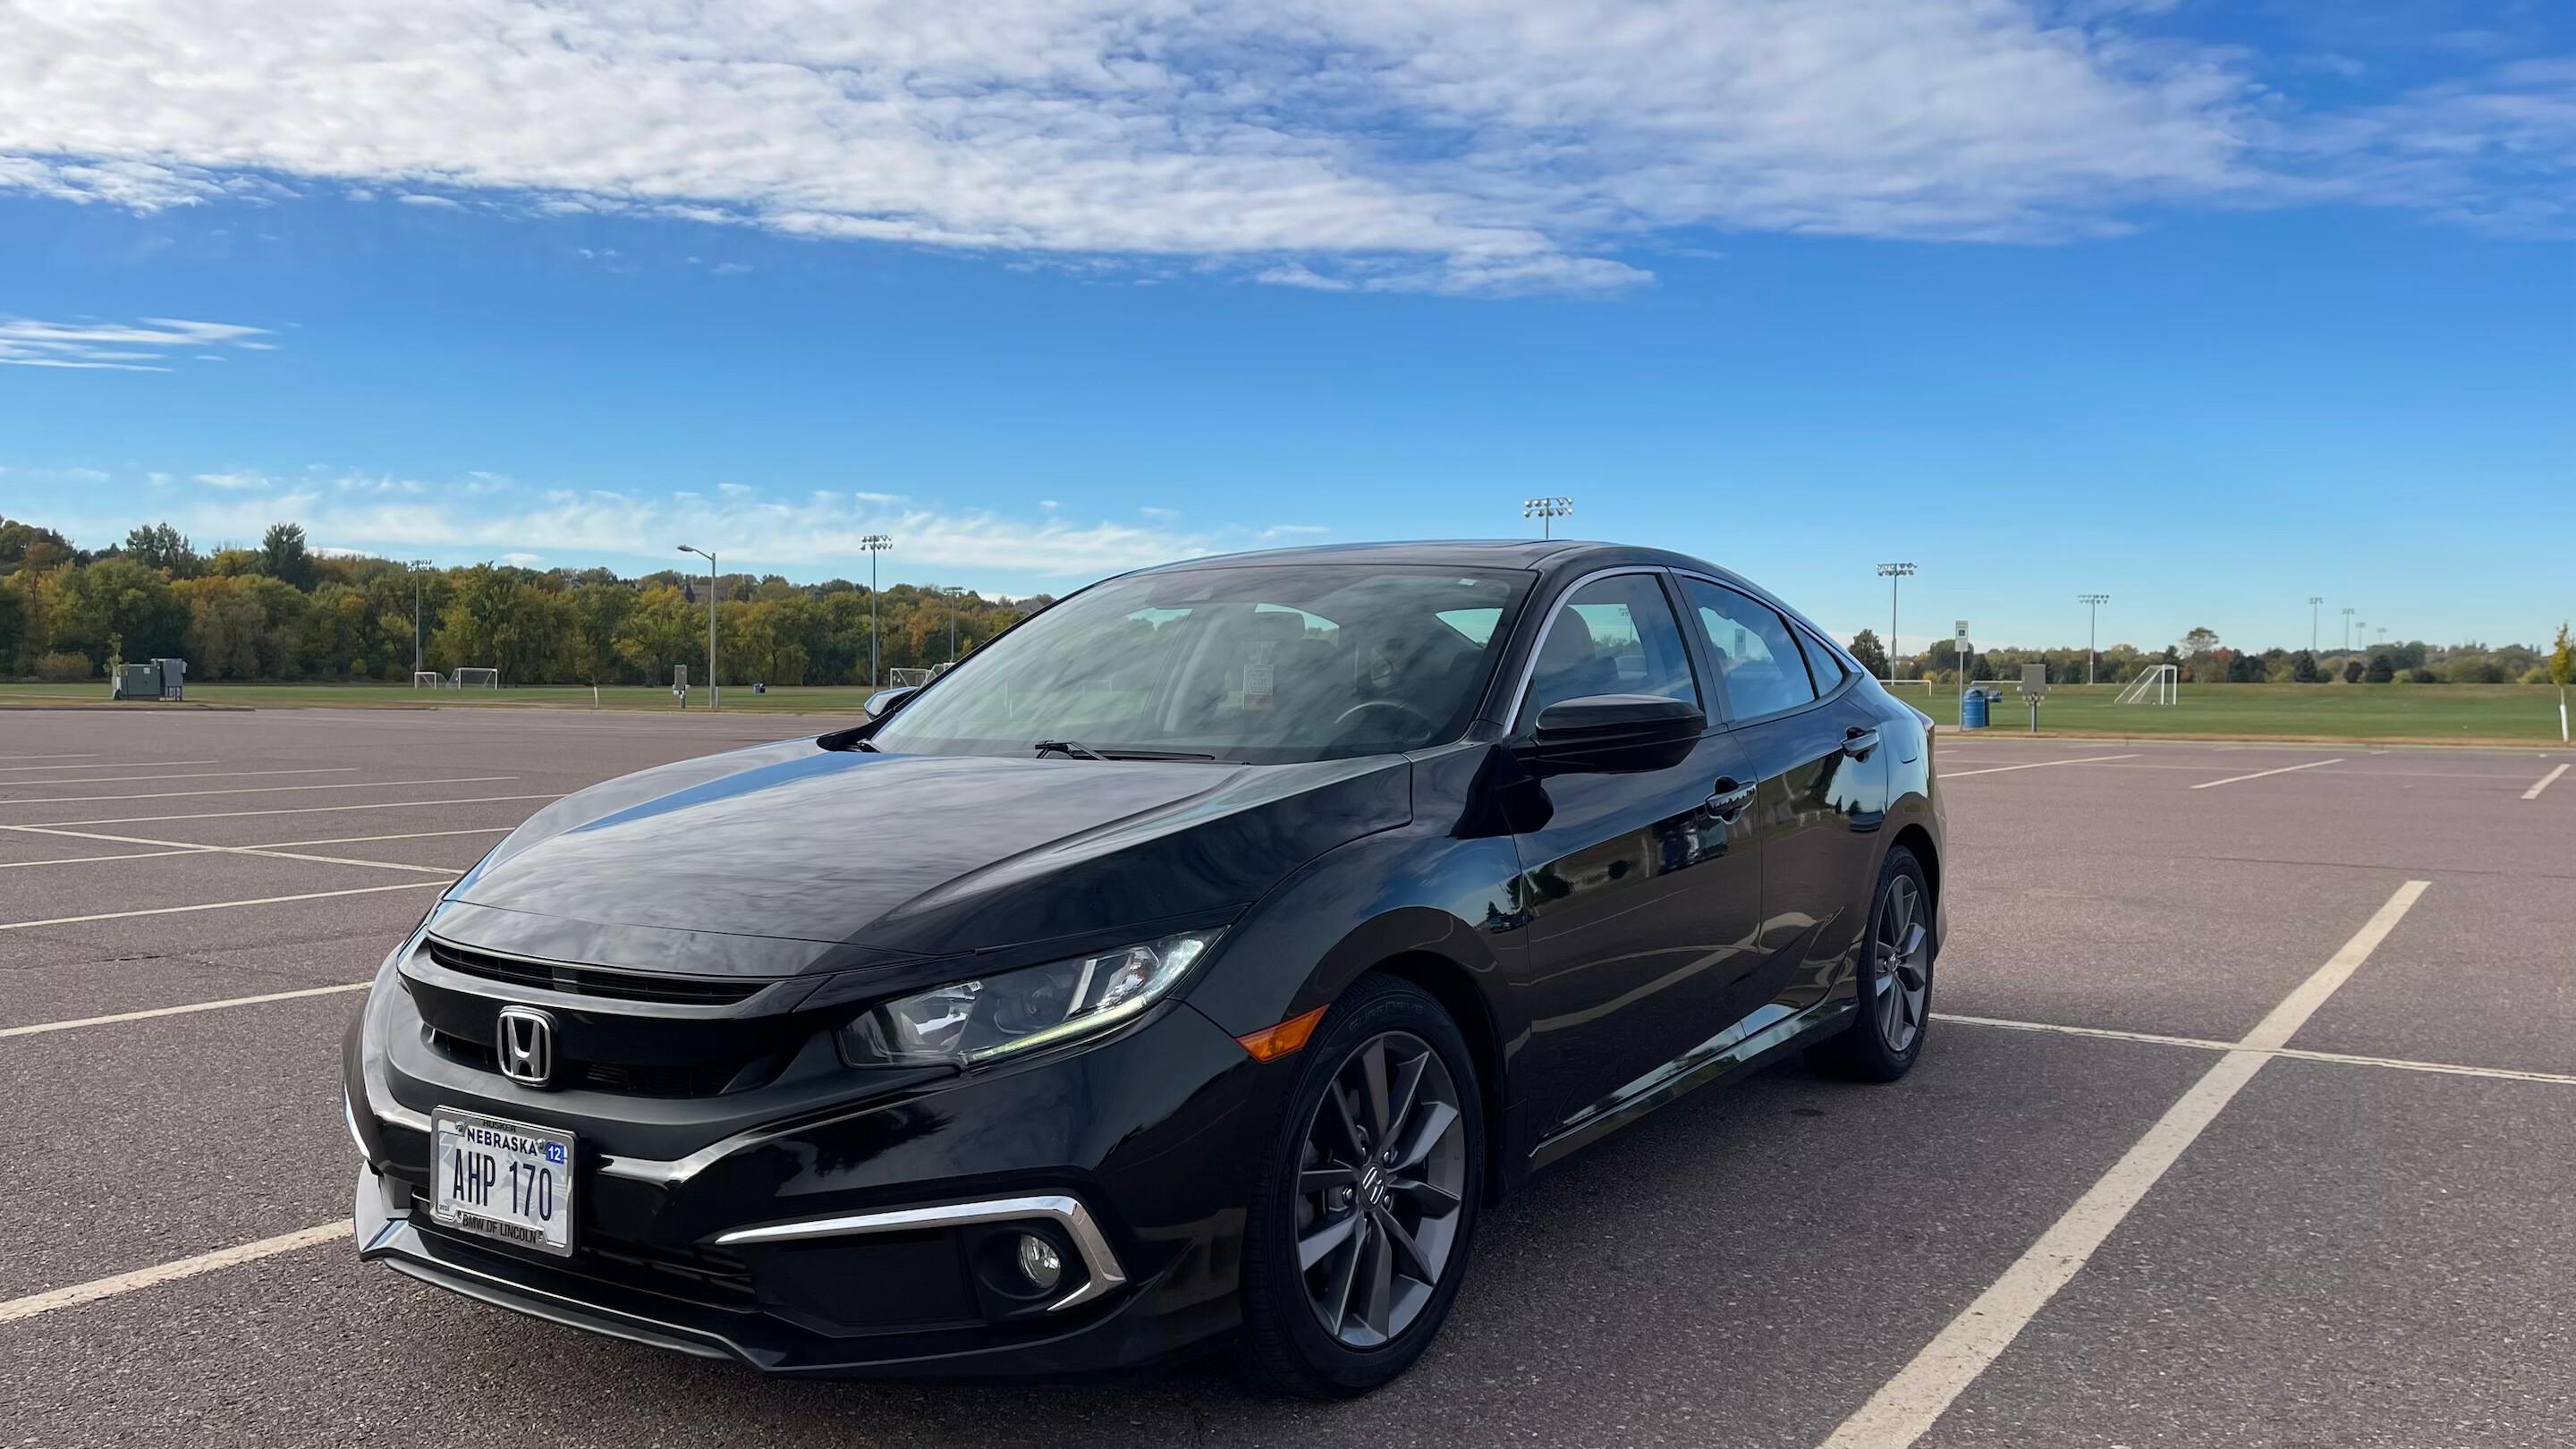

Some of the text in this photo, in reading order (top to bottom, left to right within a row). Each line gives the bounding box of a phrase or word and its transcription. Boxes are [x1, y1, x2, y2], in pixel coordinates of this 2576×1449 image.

[467, 1128, 537, 1156] NEBRASKA
[548, 1145, 561, 1161] 12
[453, 1148, 552, 1222] AHP 170
[462, 1214, 537, 1244] BMW OF LINCOLN
